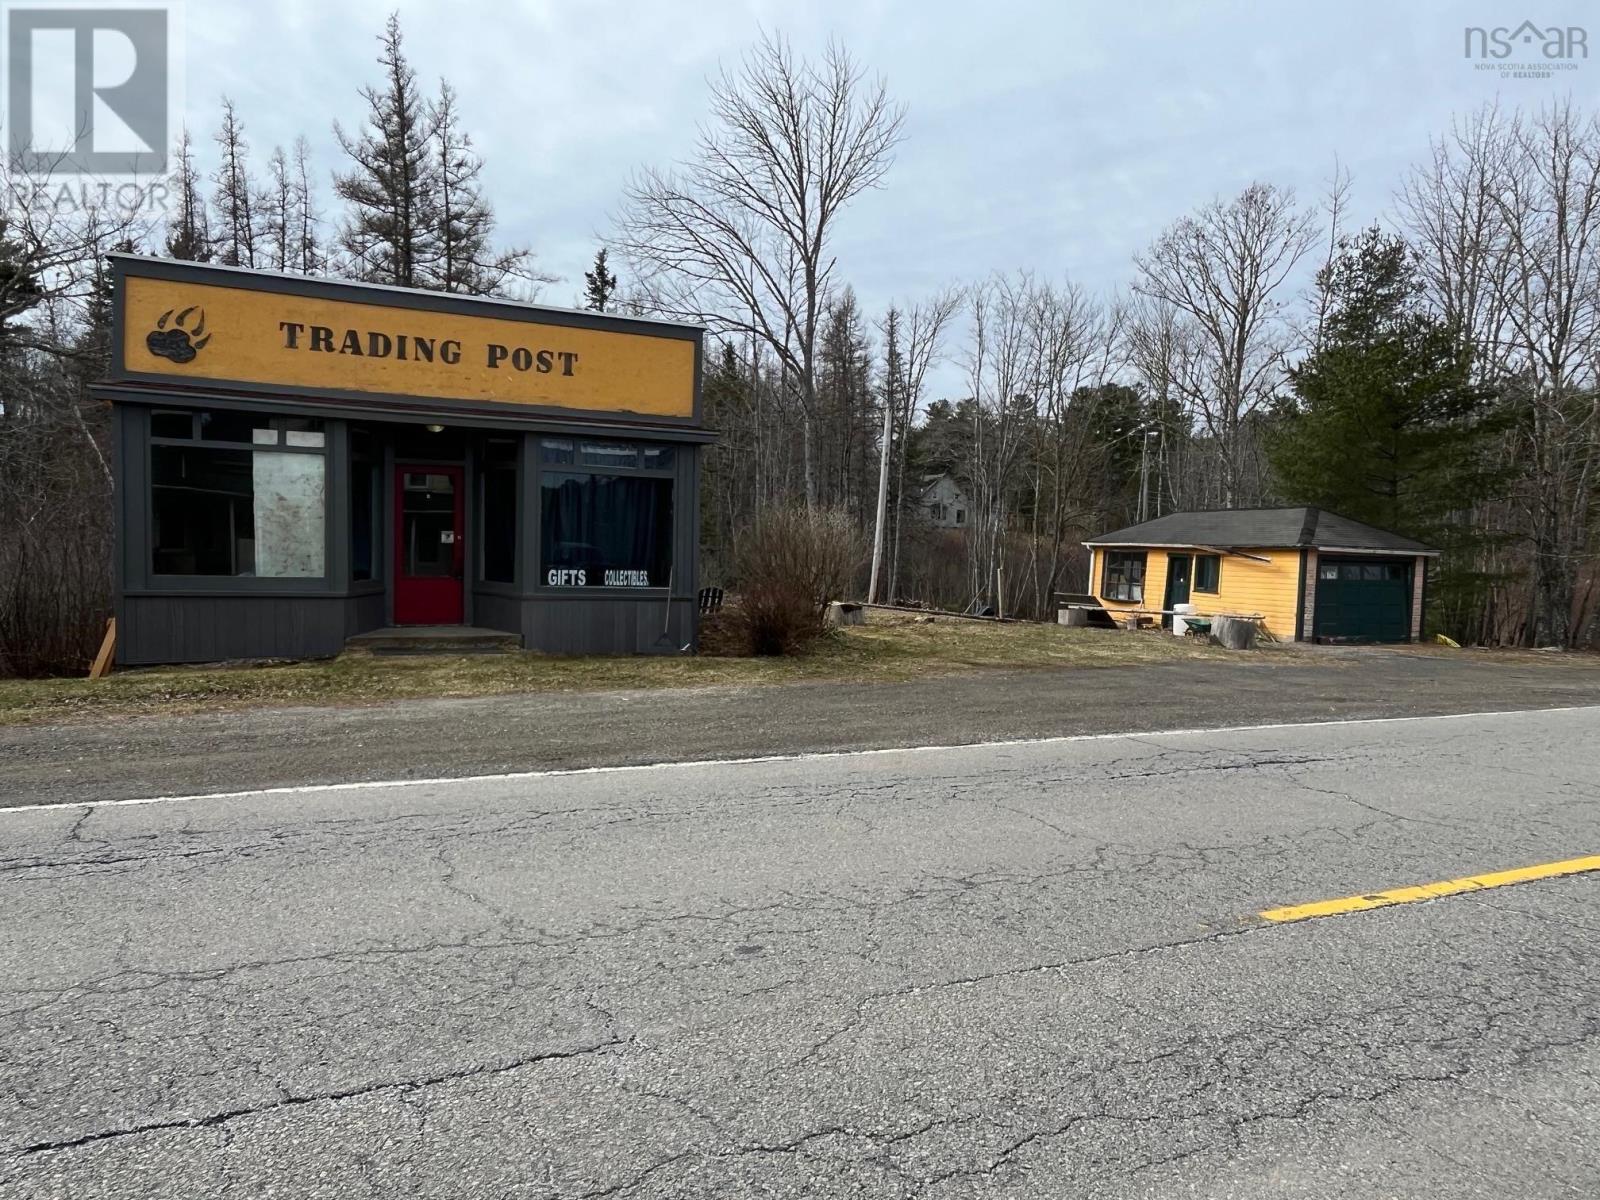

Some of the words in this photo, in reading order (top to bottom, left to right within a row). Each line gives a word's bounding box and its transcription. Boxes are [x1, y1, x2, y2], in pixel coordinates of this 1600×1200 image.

[279, 321, 461, 365] TRADING
[487, 343, 579, 377] POST
[547, 569, 587, 586] GIFTS
